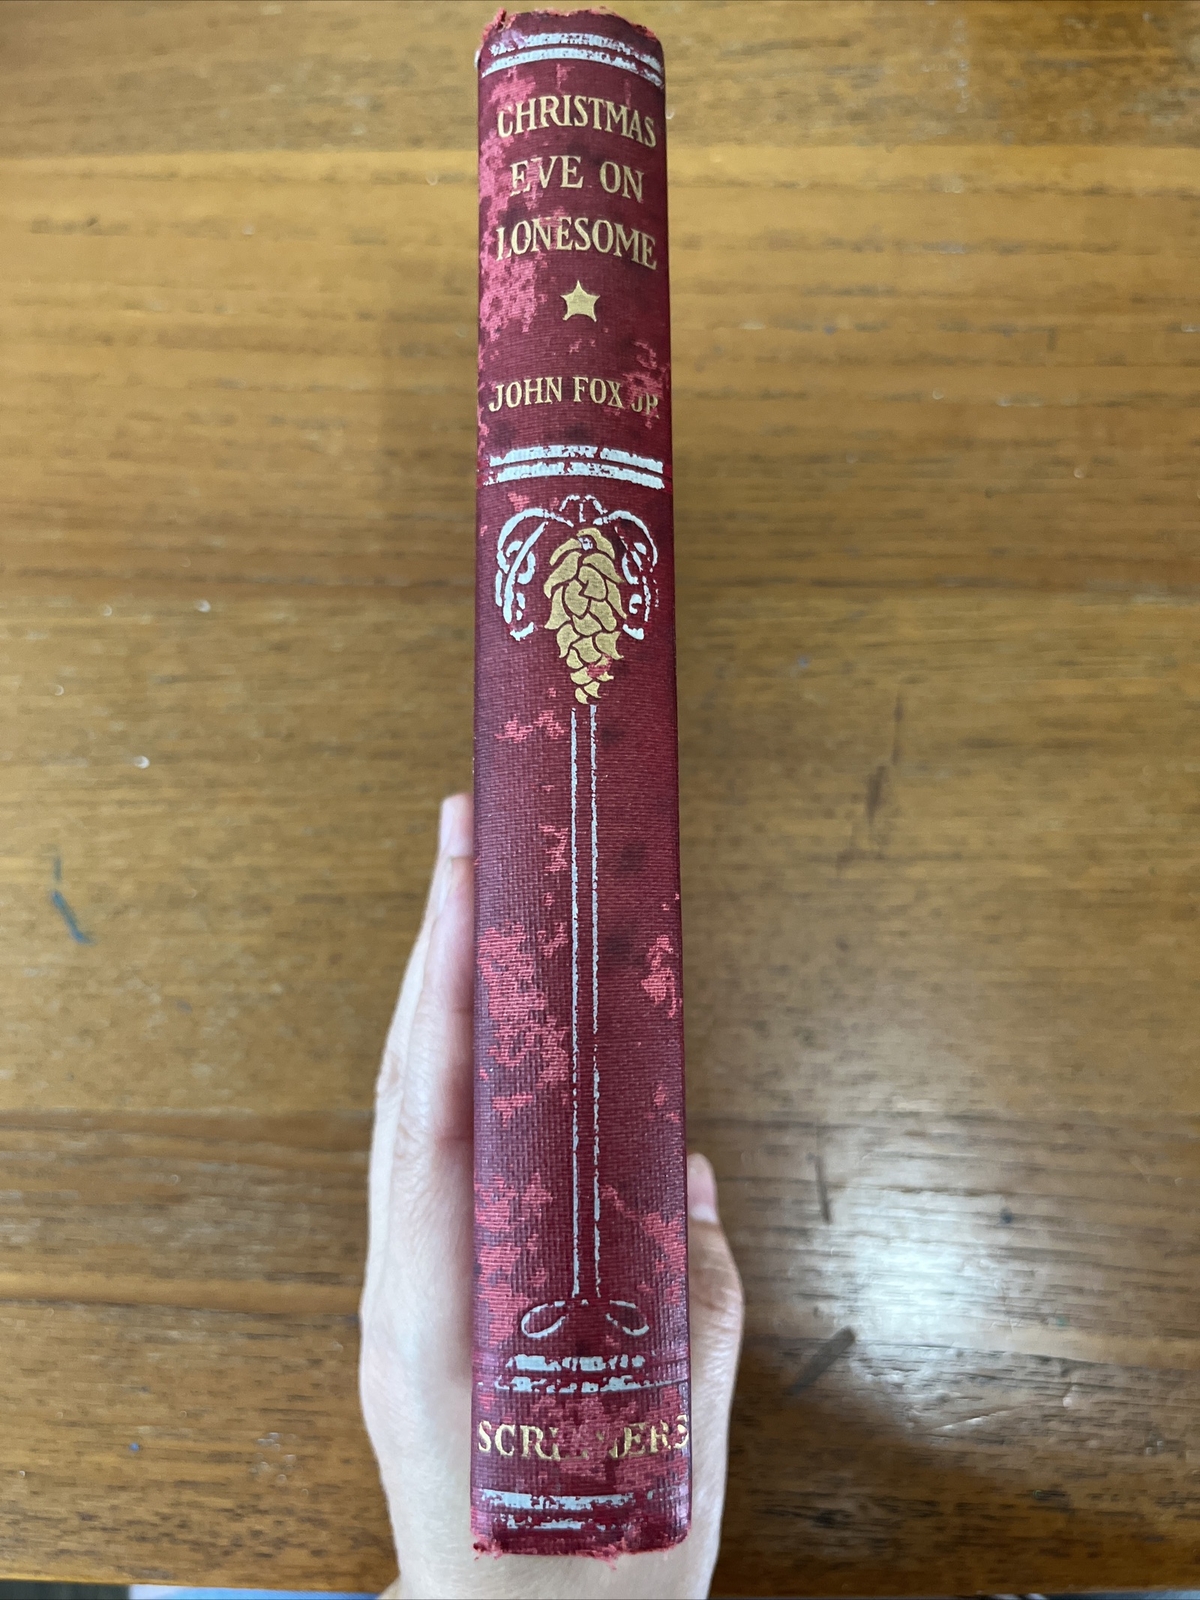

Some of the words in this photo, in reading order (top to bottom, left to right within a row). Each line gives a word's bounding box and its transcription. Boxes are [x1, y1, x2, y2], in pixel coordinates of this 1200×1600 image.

[497, 95, 657, 148] CHRISTMAS
[510, 155, 584, 196] EVE
[600, 161, 645, 204] ON
[496, 216, 657, 270] LONESOME
[488, 376, 563, 412] JOHN
[572, 376, 624, 409] FOX
